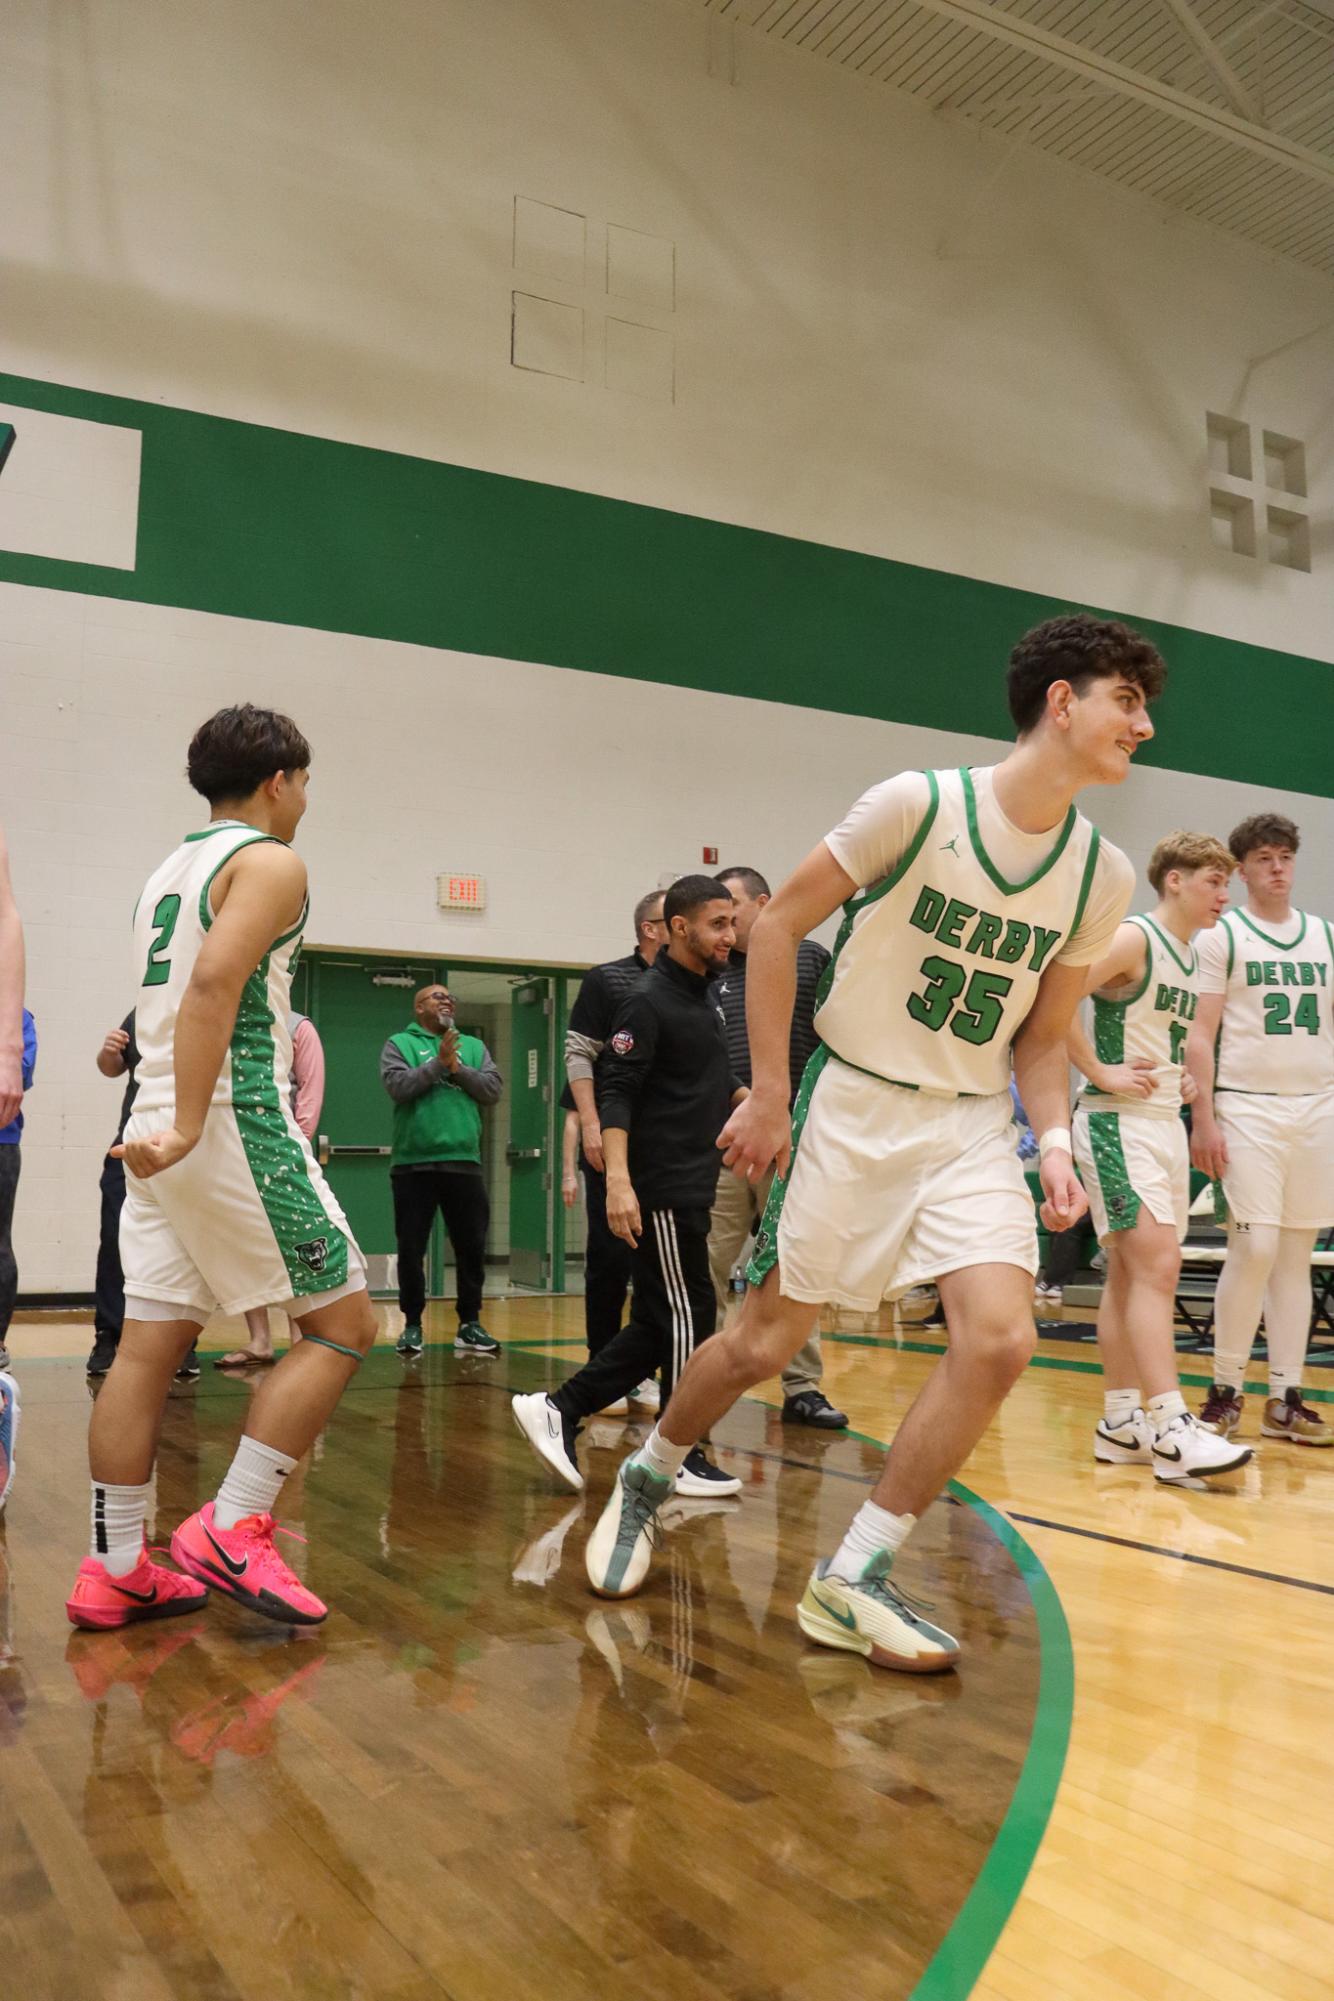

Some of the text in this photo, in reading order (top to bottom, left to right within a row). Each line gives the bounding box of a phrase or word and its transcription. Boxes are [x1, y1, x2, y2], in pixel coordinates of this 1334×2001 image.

[449, 879, 478, 902] EXIT
[142, 893, 182, 987] 2
[909, 884, 1062, 973] DERBY
[906, 955, 1014, 1047] 35
[1245, 961, 1327, 987] DERBY
[1263, 993, 1320, 1036] 24
